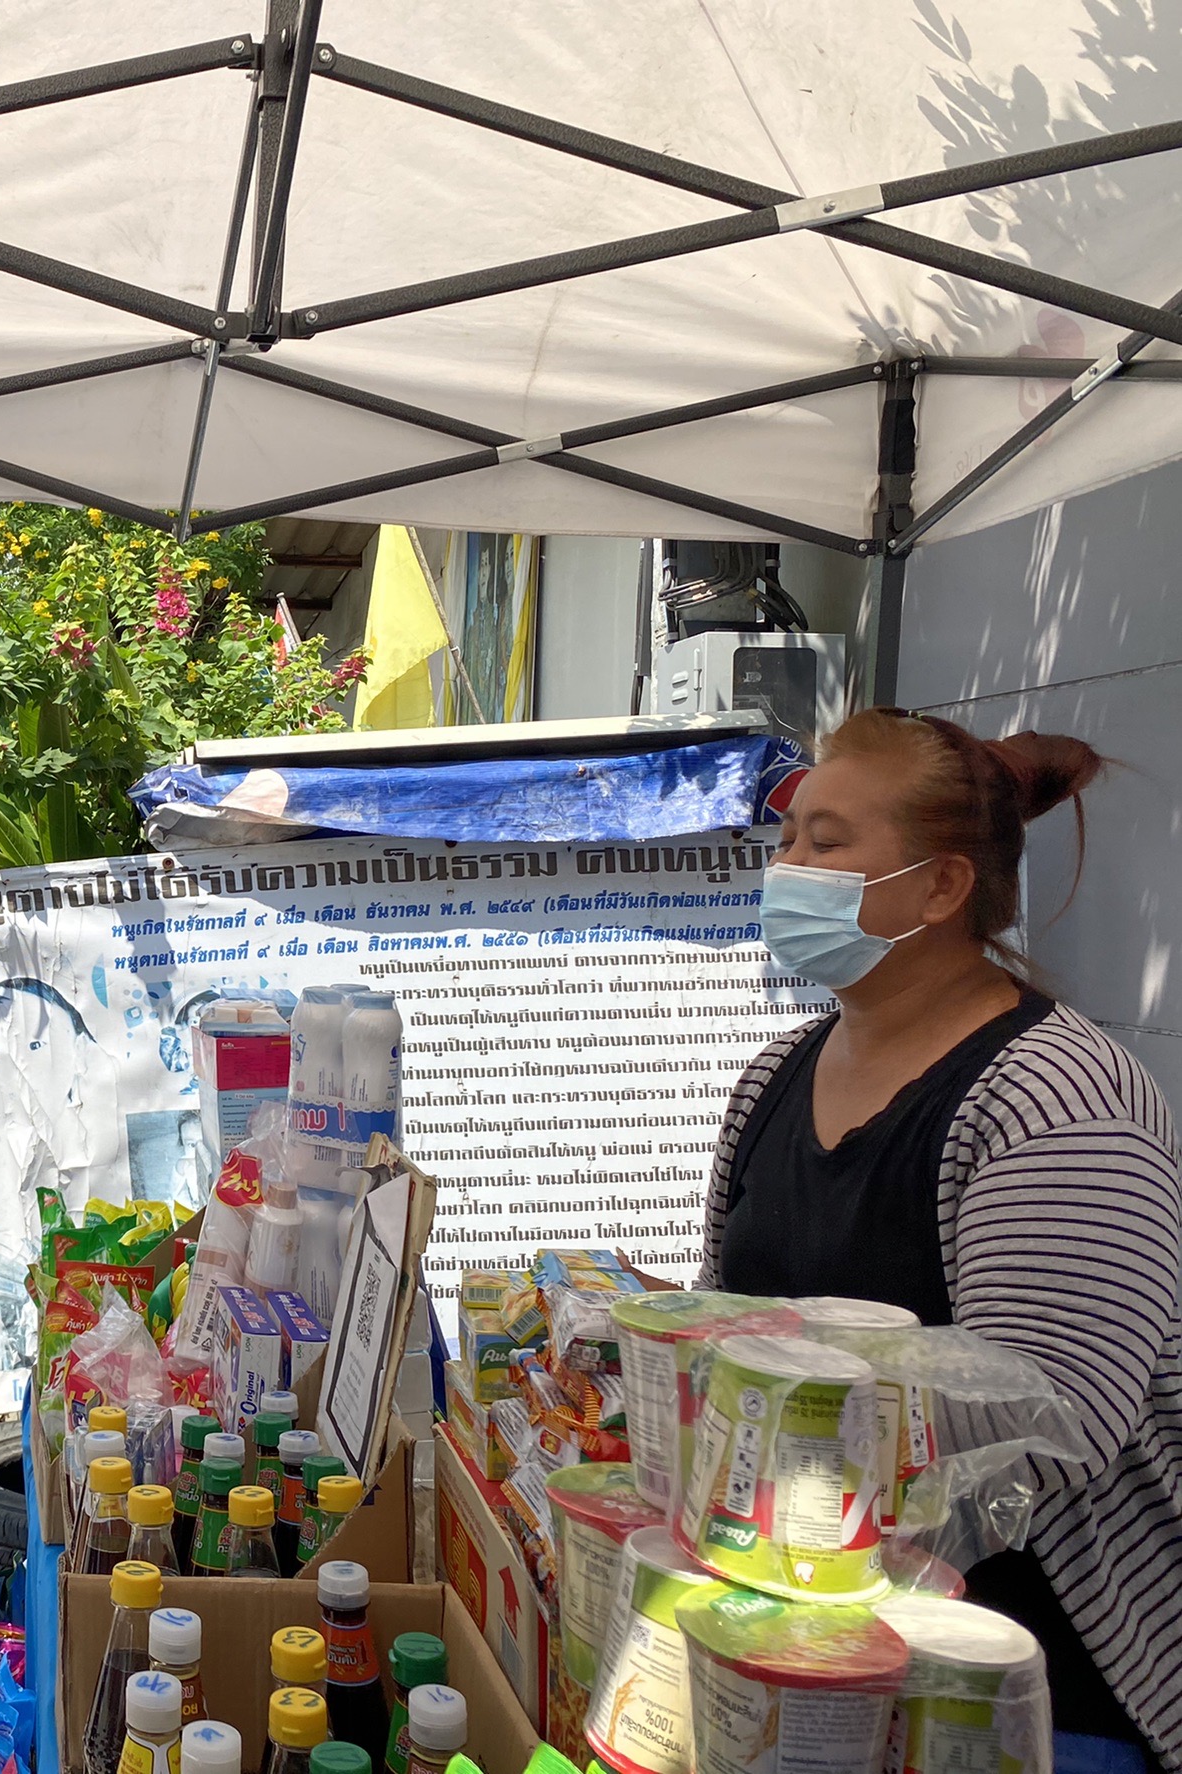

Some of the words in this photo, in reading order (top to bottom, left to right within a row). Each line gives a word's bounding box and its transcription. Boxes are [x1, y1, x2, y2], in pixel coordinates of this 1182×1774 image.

[276, 904, 306, 925] เมื่อ
[314, 904, 356, 922] เดือน
[365, 901, 431, 919] ธันวาคม
[440, 899, 476, 916] พ.ศ.
[279, 937, 308, 957] เมื่อ
[317, 936, 358, 955] เดือน
[359, 953, 568, 979] หนูเป็นเหยื่อทางการแพทย์
[575, 950, 771, 967] ตายจากการรักษาพยาบาล
[512, 1087, 676, 1105] และกระทรวงยุติธรรม
[602, 1139, 652, 1156] พ่อแม่
[240, 1371, 258, 1415] Original
[645, 1708, 674, 1735] 100%
